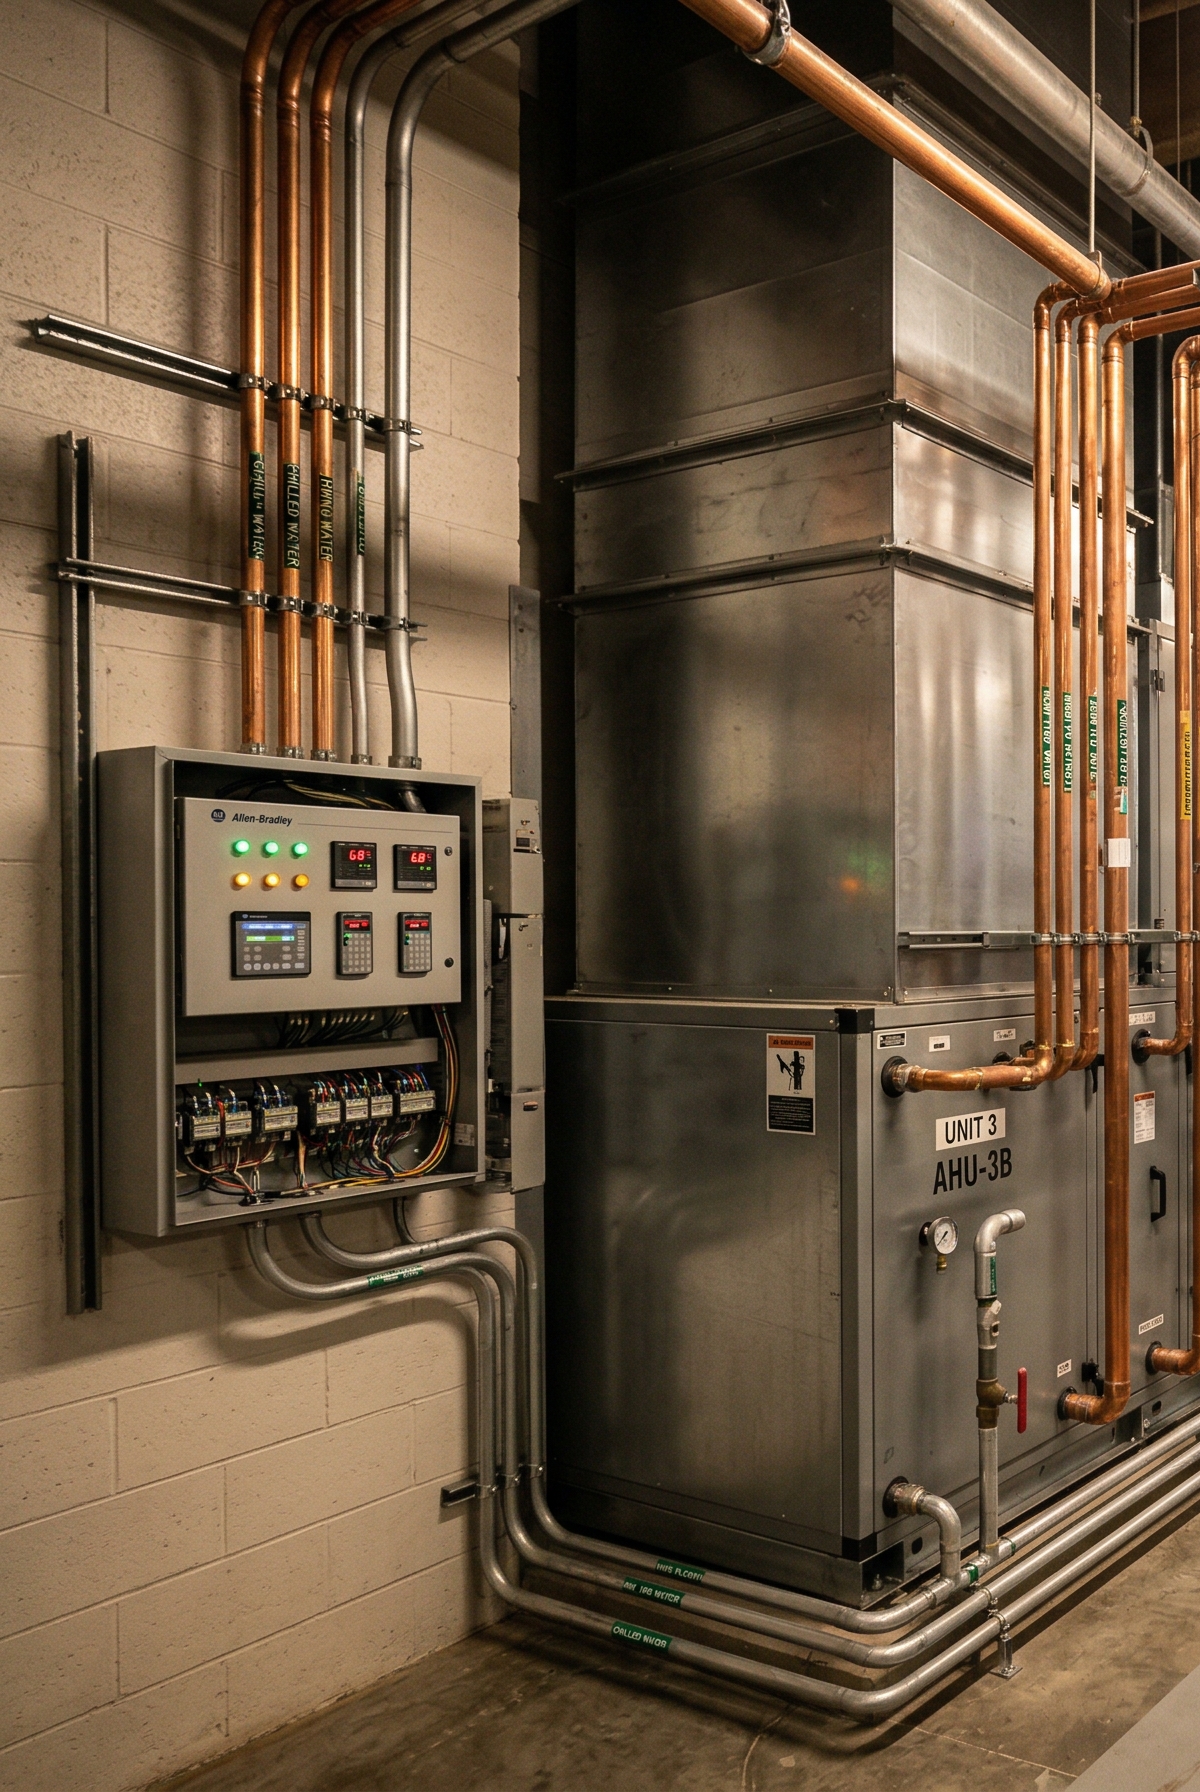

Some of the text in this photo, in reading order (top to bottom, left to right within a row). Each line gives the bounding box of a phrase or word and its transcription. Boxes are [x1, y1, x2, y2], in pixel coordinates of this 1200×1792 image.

[231, 813, 293, 827] Allen-Bradley
[945, 1113, 997, 1144] UNIT 3
[933, 1147, 1012, 1195] AHU-3B
